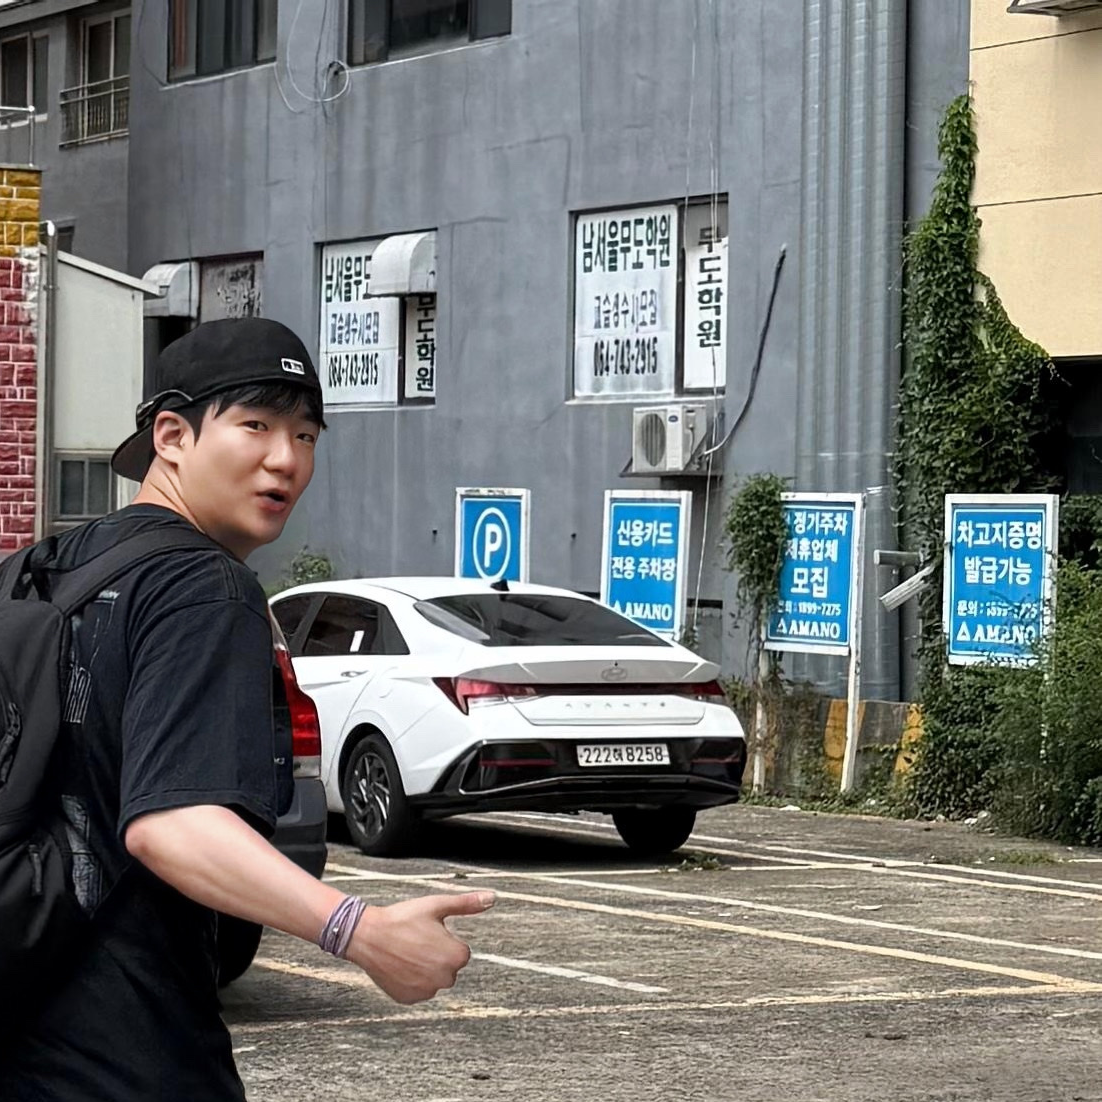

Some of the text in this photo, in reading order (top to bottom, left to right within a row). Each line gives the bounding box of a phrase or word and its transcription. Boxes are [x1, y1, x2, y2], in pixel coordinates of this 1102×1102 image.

[582, 214, 671, 273] 남서울무도학원
[325, 255, 372, 302] 남서울무도
[697, 226, 723, 348] 무도학원
[617, 519, 674, 547] 신용카드
[793, 511, 848, 536] 정기주차
[956, 520, 1042, 549] 차고지증명
[484, 523, 503, 568] P
[784, 537, 839, 563] 제휴업체
[612, 556, 676, 581] 전용 주차장
[790, 566, 829, 598] 모집
[964, 556, 1032, 585] 발급가능
[624, 602, 673, 621] AMANO
[789, 619, 841, 639] AMANO
